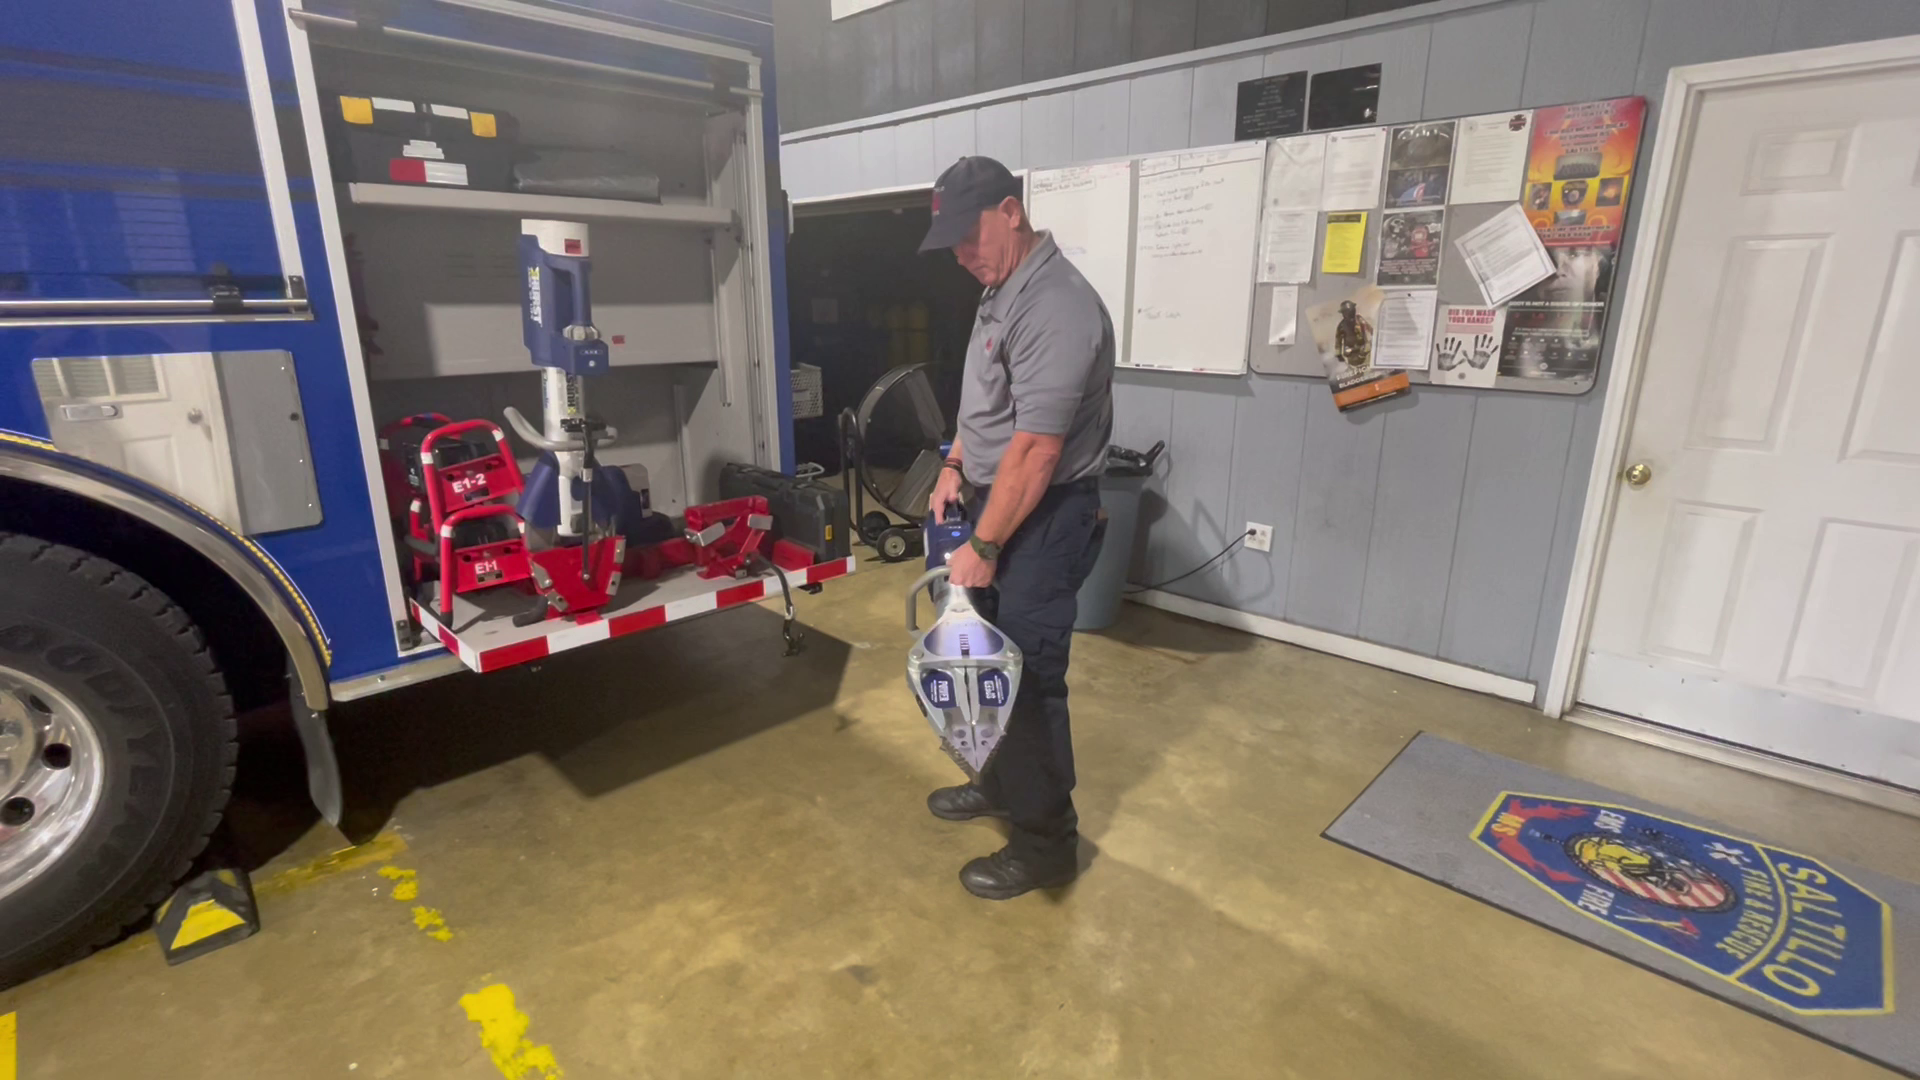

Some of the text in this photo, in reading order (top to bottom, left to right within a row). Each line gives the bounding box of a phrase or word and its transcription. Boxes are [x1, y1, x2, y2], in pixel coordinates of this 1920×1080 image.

[451, 472, 487, 494] E1-2
[474, 559, 498, 575] E1-1
[1491, 813, 1525, 837] MS
[1594, 809, 1626, 834] EMS
[1740, 866, 1774, 901] FIRE
[1577, 882, 1616, 917] FIRE
[1715, 909, 1774, 961] RESCUE
[1762, 863, 1847, 997] SALTILLO
